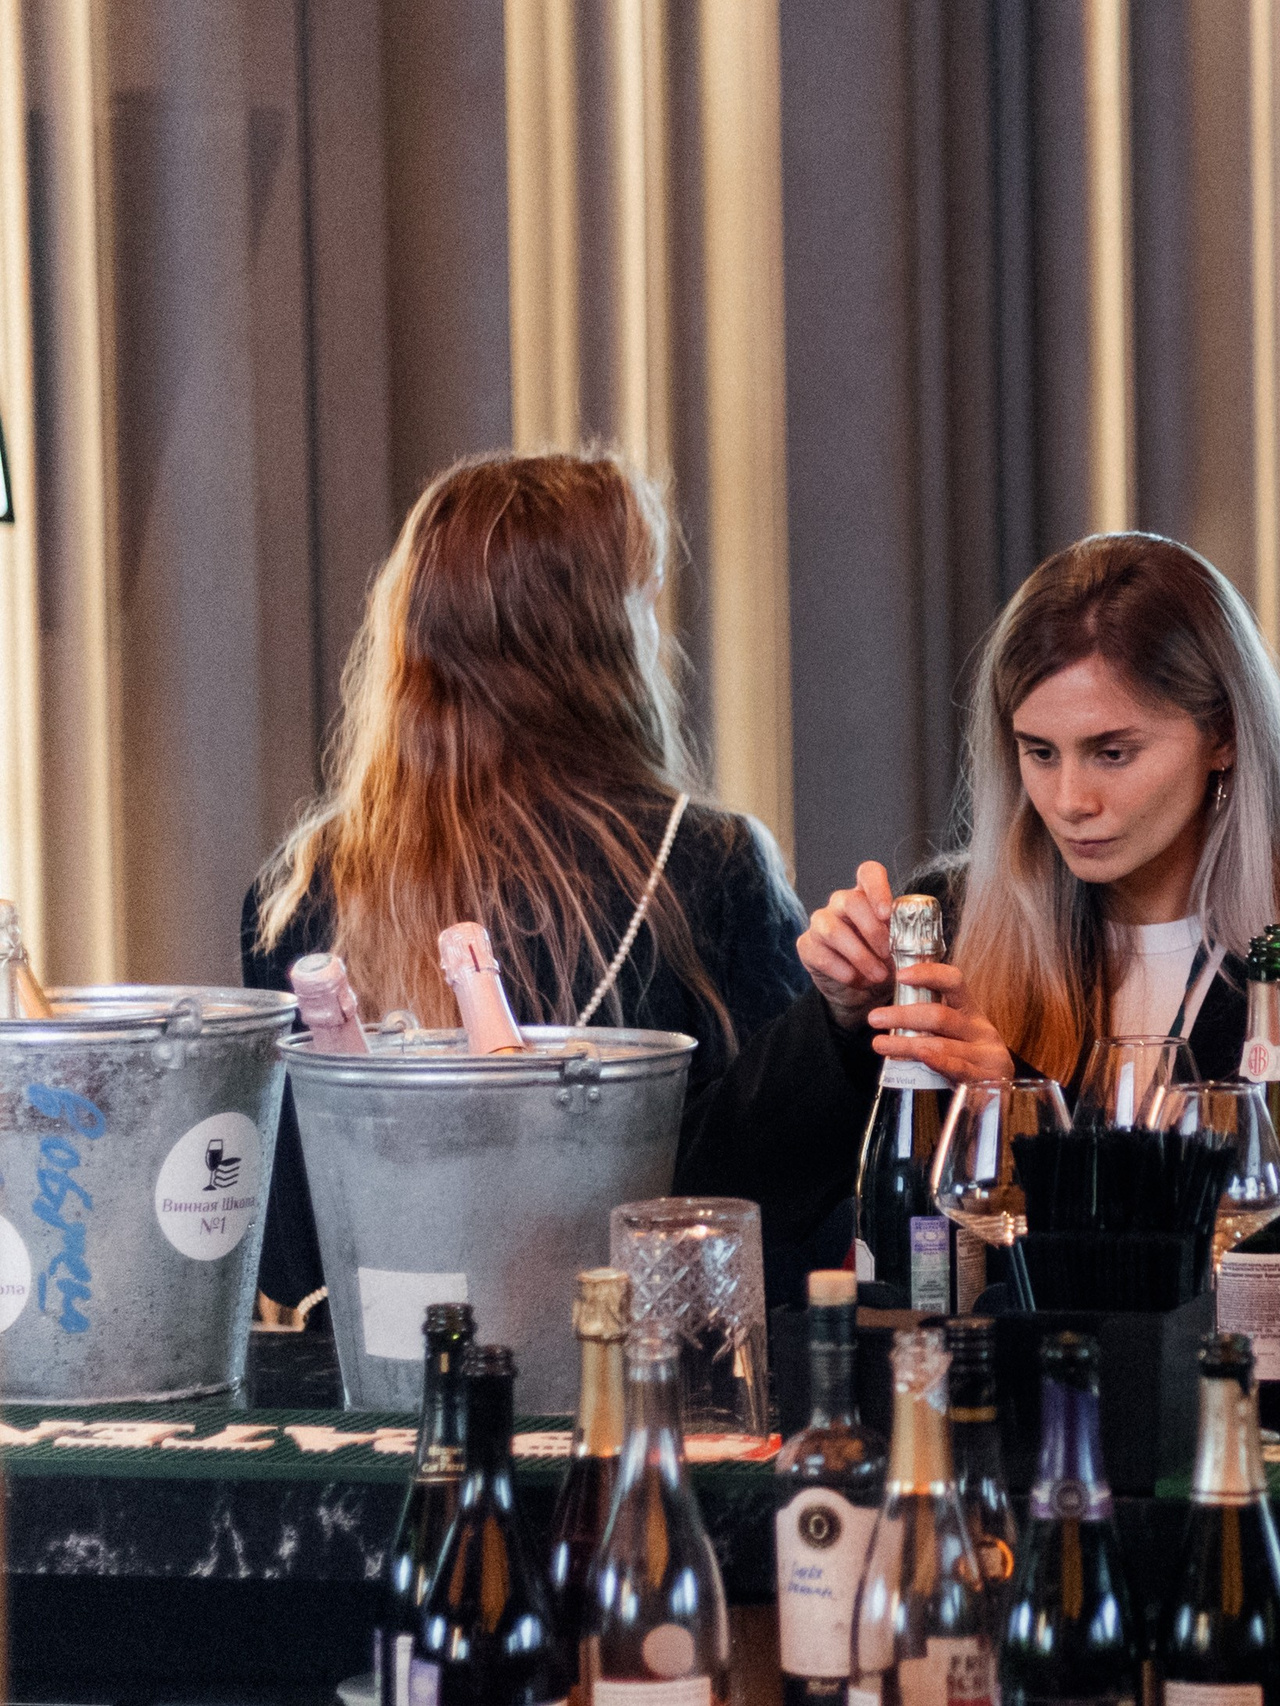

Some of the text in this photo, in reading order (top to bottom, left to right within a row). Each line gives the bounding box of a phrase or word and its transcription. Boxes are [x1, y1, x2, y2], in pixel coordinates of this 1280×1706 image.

[162, 1198, 218, 1213] Винная
[200, 1216, 227, 1236] №1
[0, 1284, 26, 1296] ола
